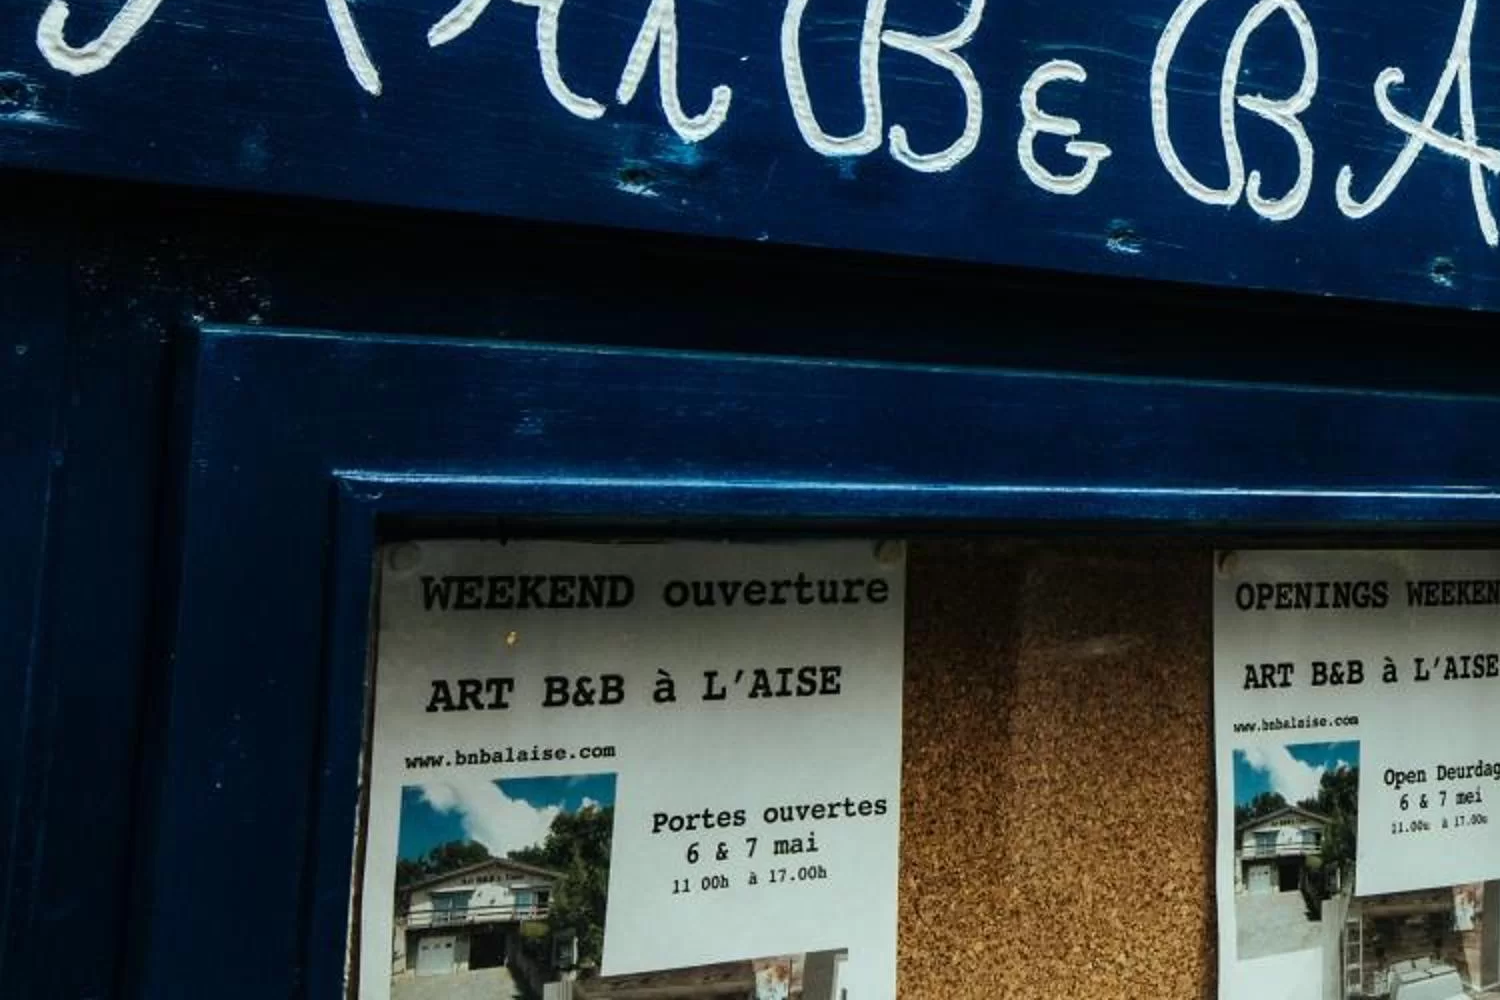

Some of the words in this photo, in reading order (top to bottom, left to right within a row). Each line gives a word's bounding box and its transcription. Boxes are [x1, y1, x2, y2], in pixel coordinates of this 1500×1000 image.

[420, 574, 635, 611] WEEKEND
[662, 571, 889, 609] ouverture
[1235, 579, 1390, 611] OPENINGS
[1243, 662, 1295, 690] ART
[1311, 659, 1365, 687] B&B
[1381, 655, 1398, 684] à
[1413, 653, 1499, 682] L'AISE
[425, 677, 515, 713] ART
[541, 673, 625, 708] B&B
[652, 668, 677, 704] à
[701, 665, 842, 701] L'AISE
[1233, 715, 1360, 733] www.bnbalaise.com
[404, 745, 617, 770] www.bnbalaise.com
[1383, 768, 1427, 791] Open
[1399, 793, 1409, 811] 6
[1419, 793, 1429, 809] &
[1438, 790, 1447, 807] 7
[1455, 786, 1483, 805] mei
[651, 807, 747, 834] Portes
[763, 797, 887, 824] ouvertes
[686, 841, 700, 865] 6
[715, 841, 729, 861] &
[745, 837, 758, 858] 7
[773, 831, 819, 856] mai
[748, 871, 758, 886] à
[769, 864, 828, 884] 17.00h
